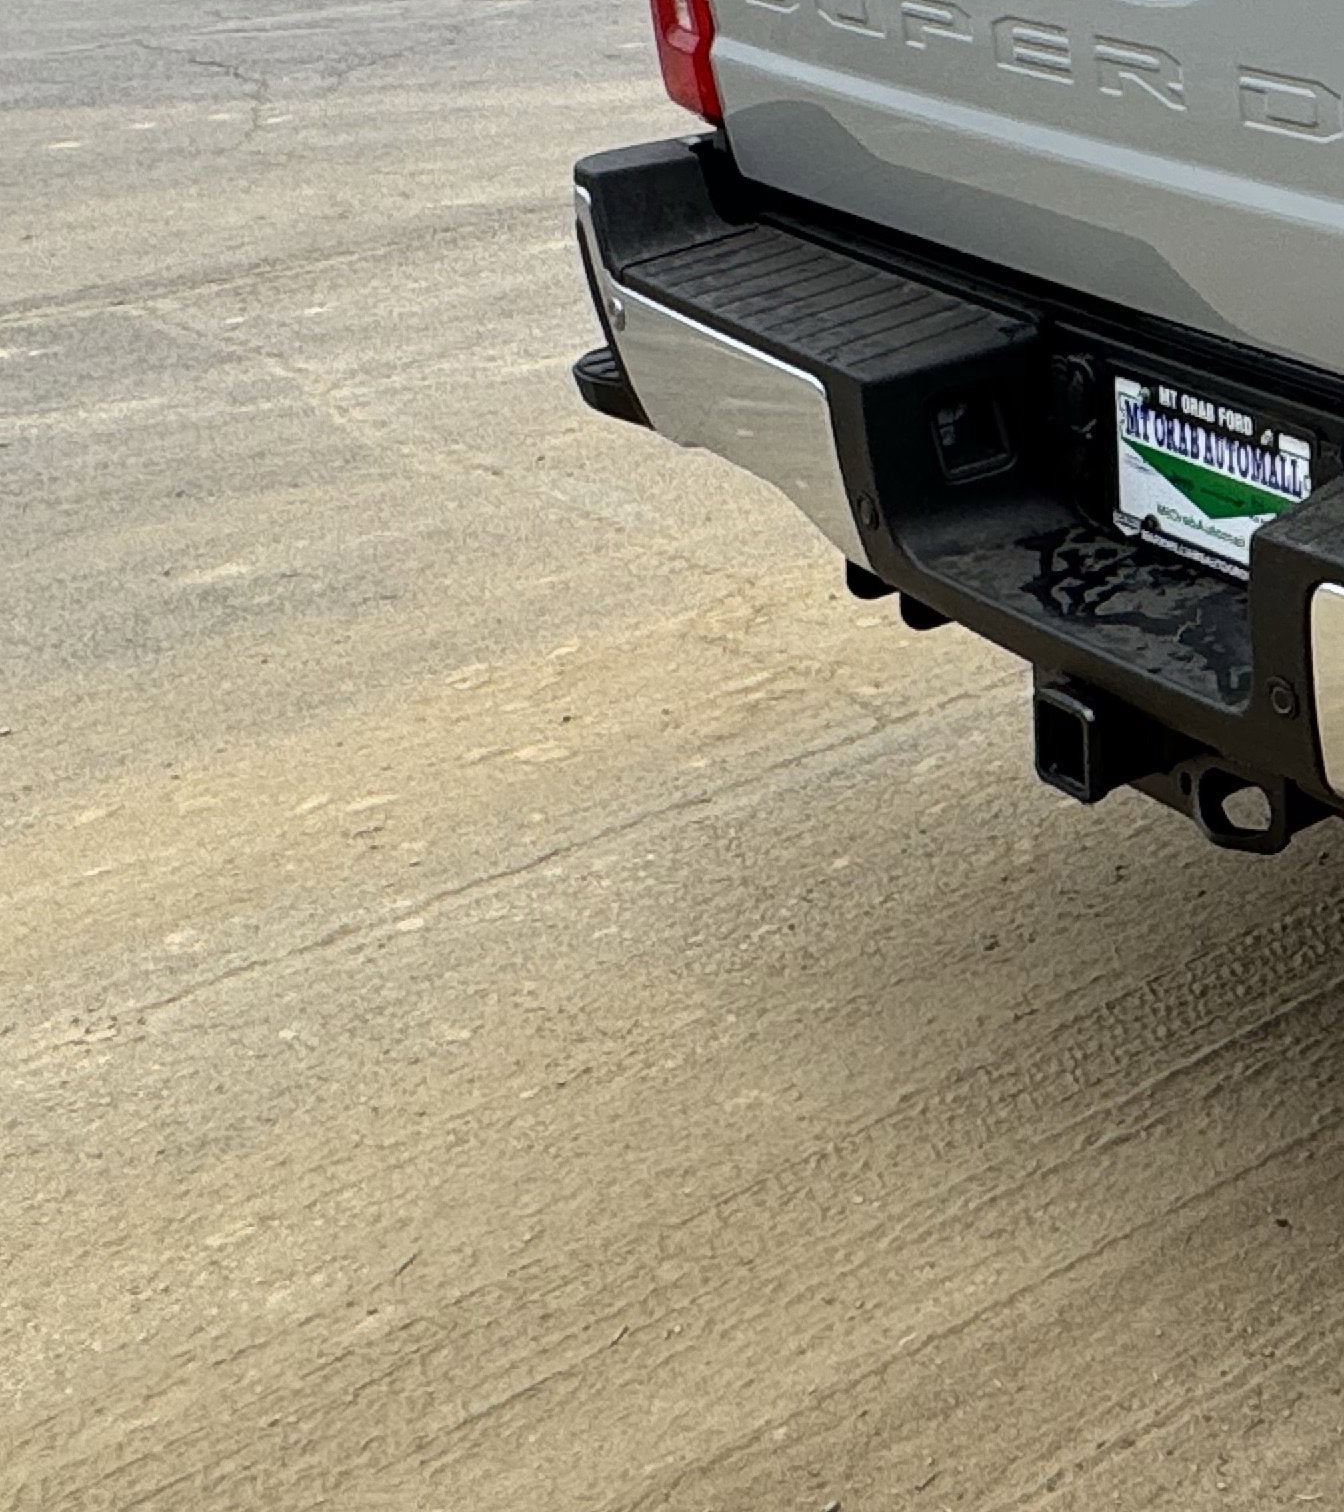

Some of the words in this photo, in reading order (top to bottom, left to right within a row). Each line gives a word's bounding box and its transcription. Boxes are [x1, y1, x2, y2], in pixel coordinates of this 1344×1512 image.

[1158, 384, 1178, 410] MT
[1180, 394, 1216, 424] ORAB
[1217, 406, 1254, 437] FORD
[1154, 413, 1201, 460] ORAB
